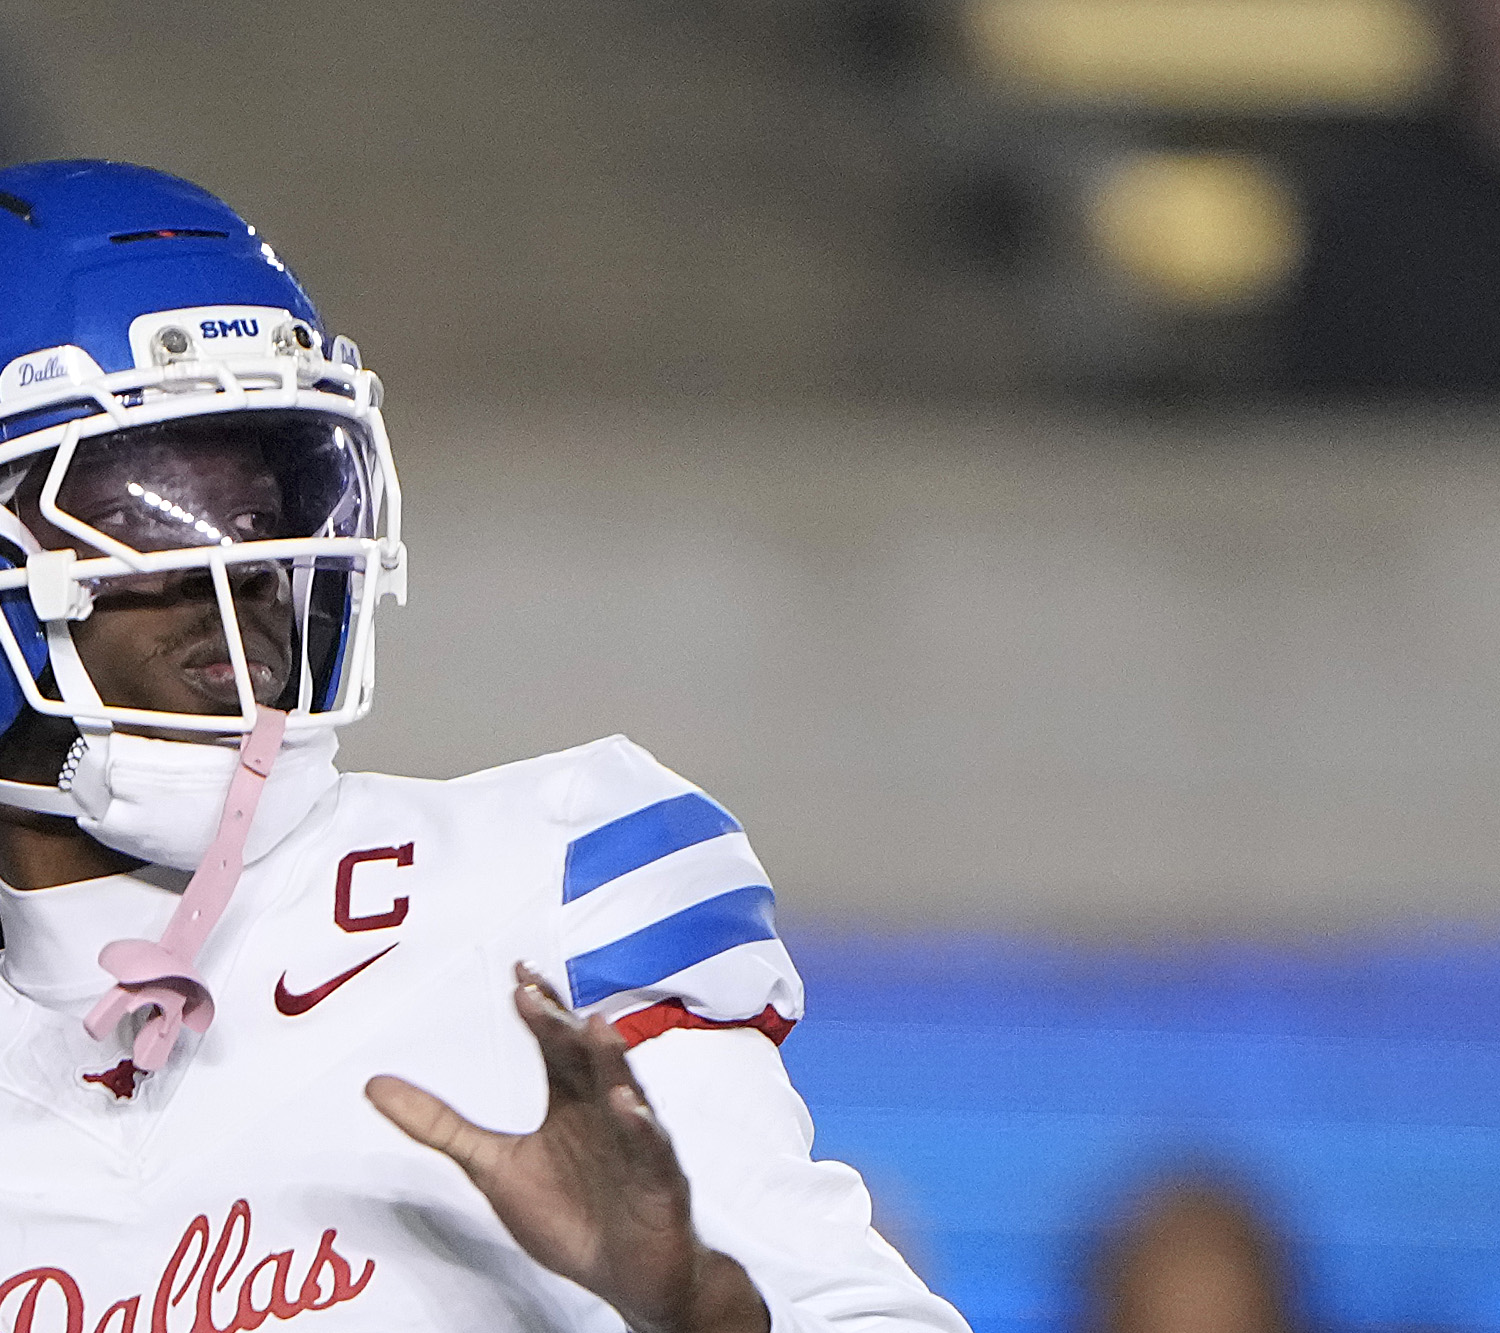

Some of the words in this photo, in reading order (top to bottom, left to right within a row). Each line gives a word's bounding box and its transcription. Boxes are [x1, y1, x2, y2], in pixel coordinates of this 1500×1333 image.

[199, 319, 259, 339] SMU
[18, 355, 70, 387] Dalla
[334, 843, 414, 934] C
